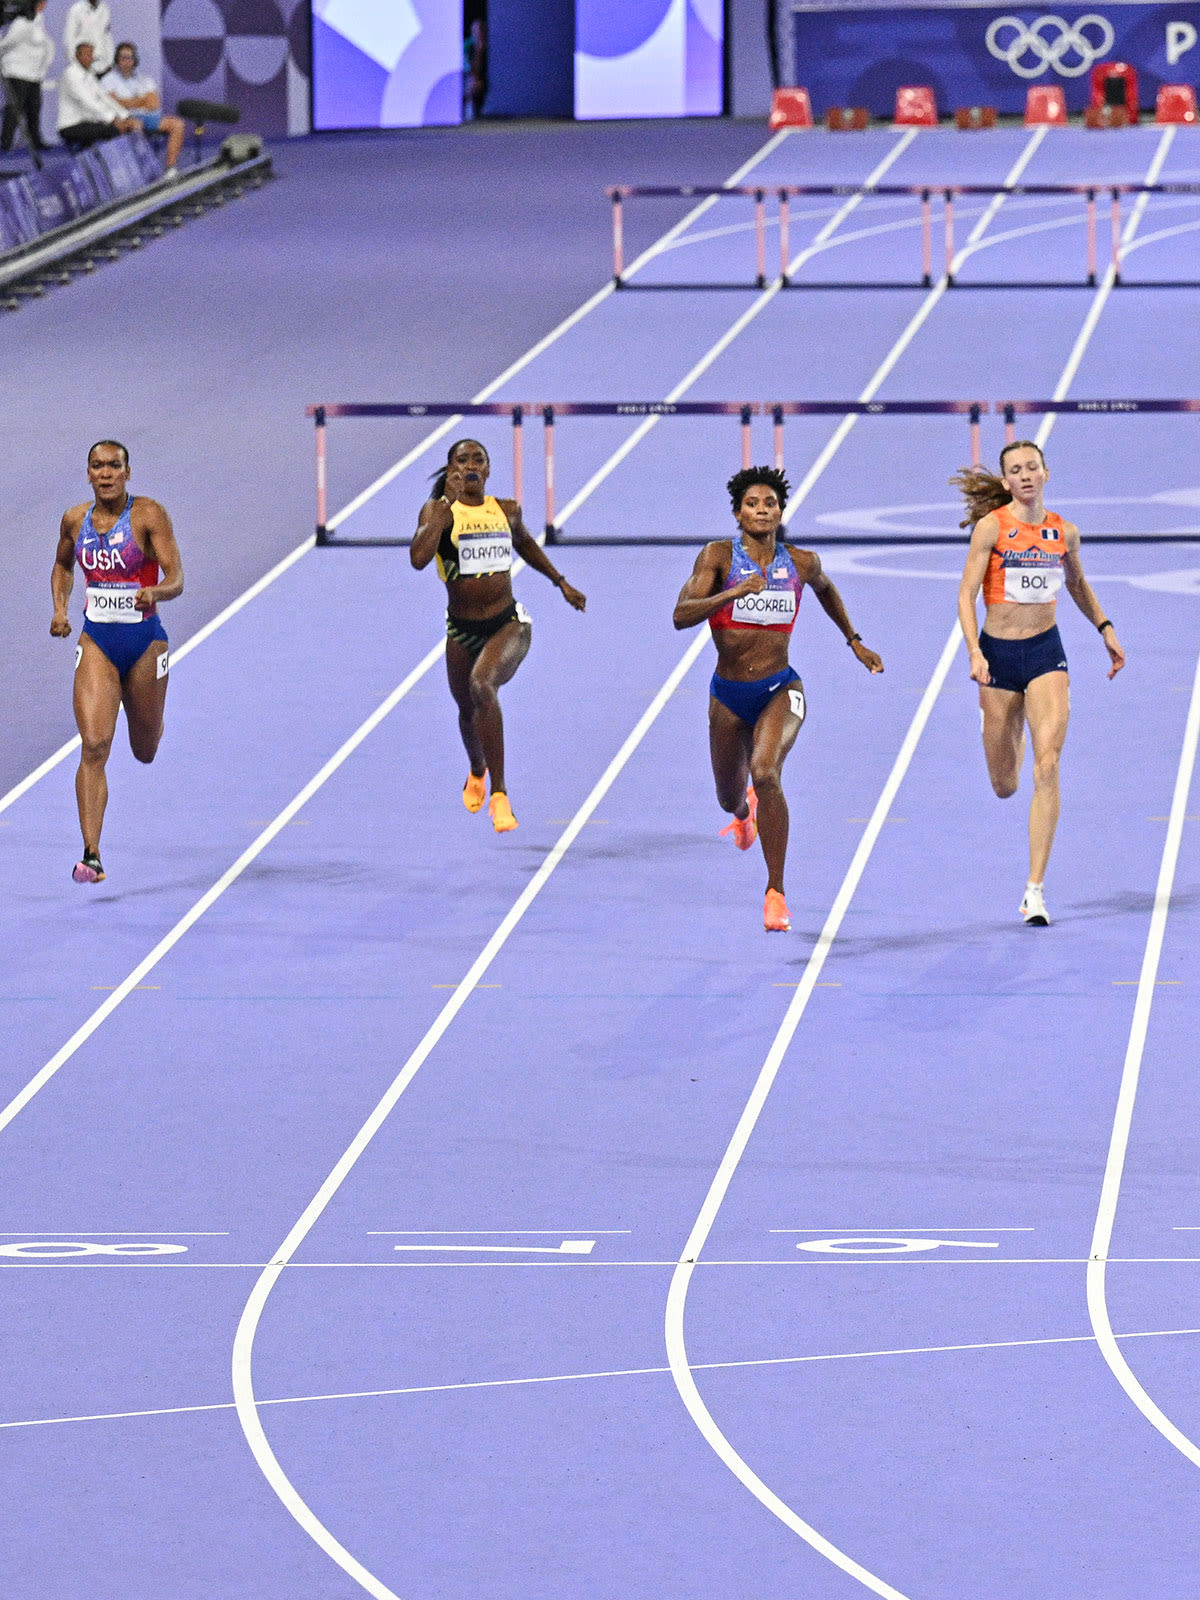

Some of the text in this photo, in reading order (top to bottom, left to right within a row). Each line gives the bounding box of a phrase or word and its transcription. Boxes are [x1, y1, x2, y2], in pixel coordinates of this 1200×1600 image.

[82, 547, 127, 571] USA
[1021, 575, 1049, 589] BOL
[94, 596, 134, 609] JONES
[737, 598, 794, 613] COCKRELL
[795, 695, 802, 710] 7
